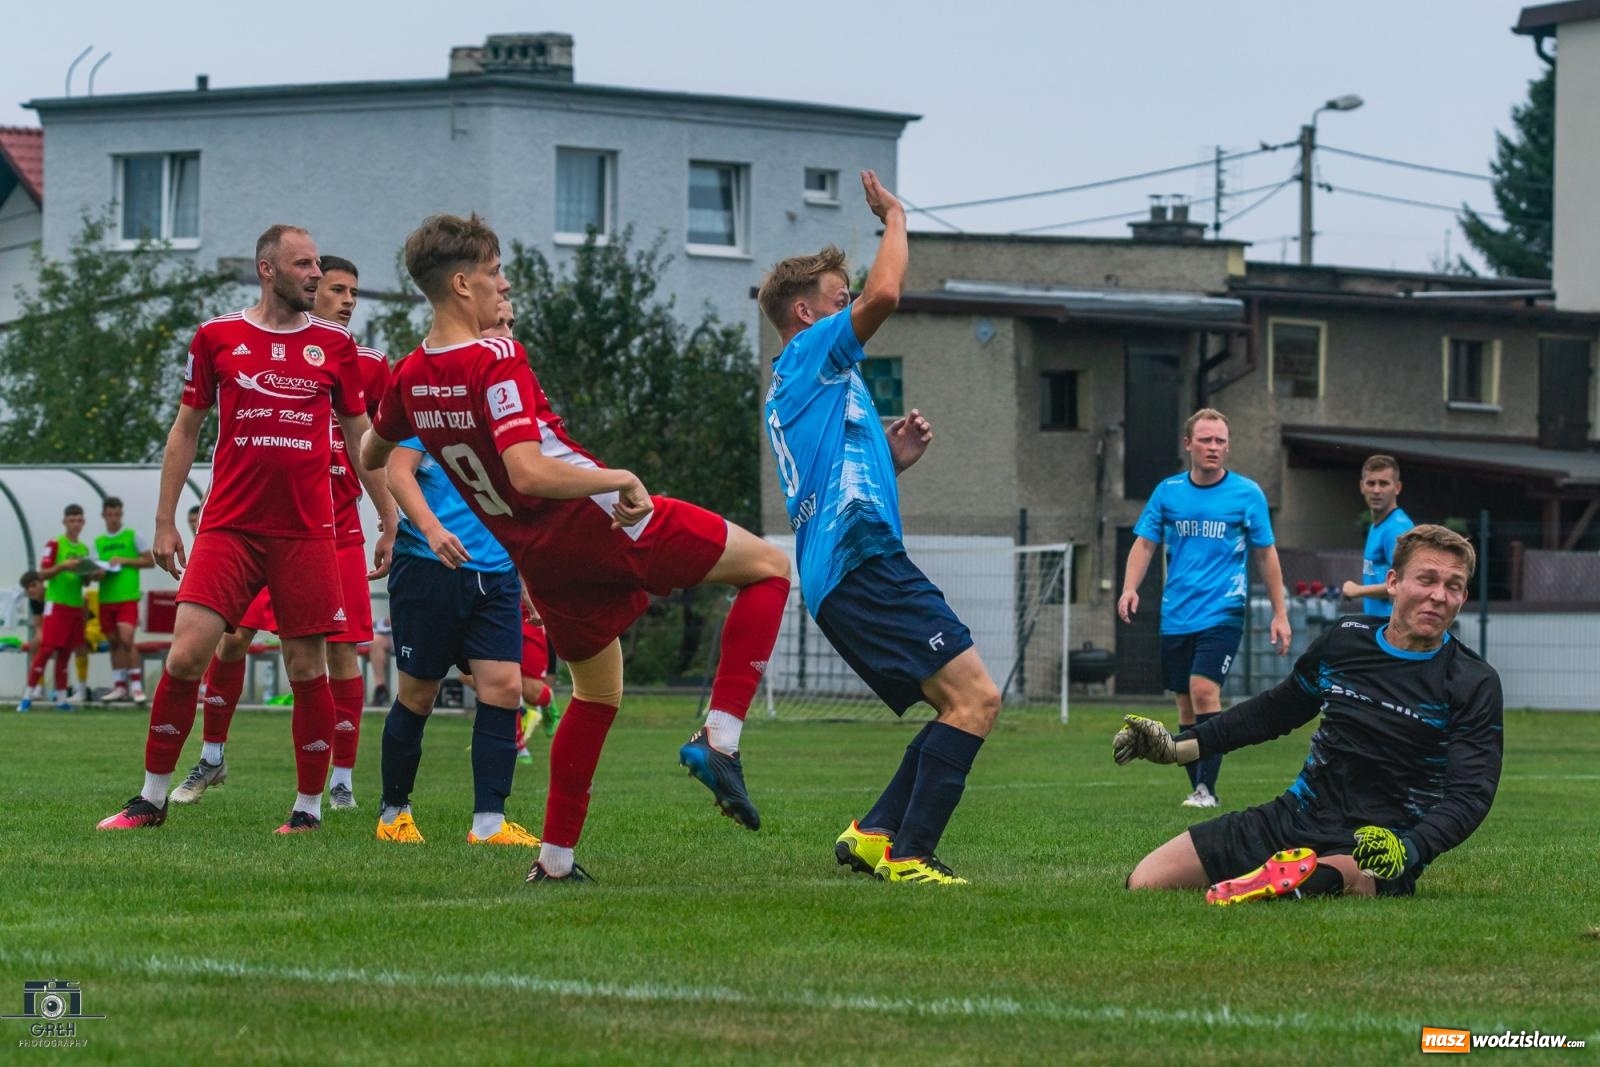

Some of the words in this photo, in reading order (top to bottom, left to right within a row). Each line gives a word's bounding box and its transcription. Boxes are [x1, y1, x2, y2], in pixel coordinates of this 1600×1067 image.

[235, 408, 274, 420] SACHS
[278, 409, 314, 422] TRANS
[413, 410, 445, 429] UNIA
[251, 436, 313, 451] WENINGER
[441, 443, 513, 518] 9
[1221, 654, 1232, 675] 5
